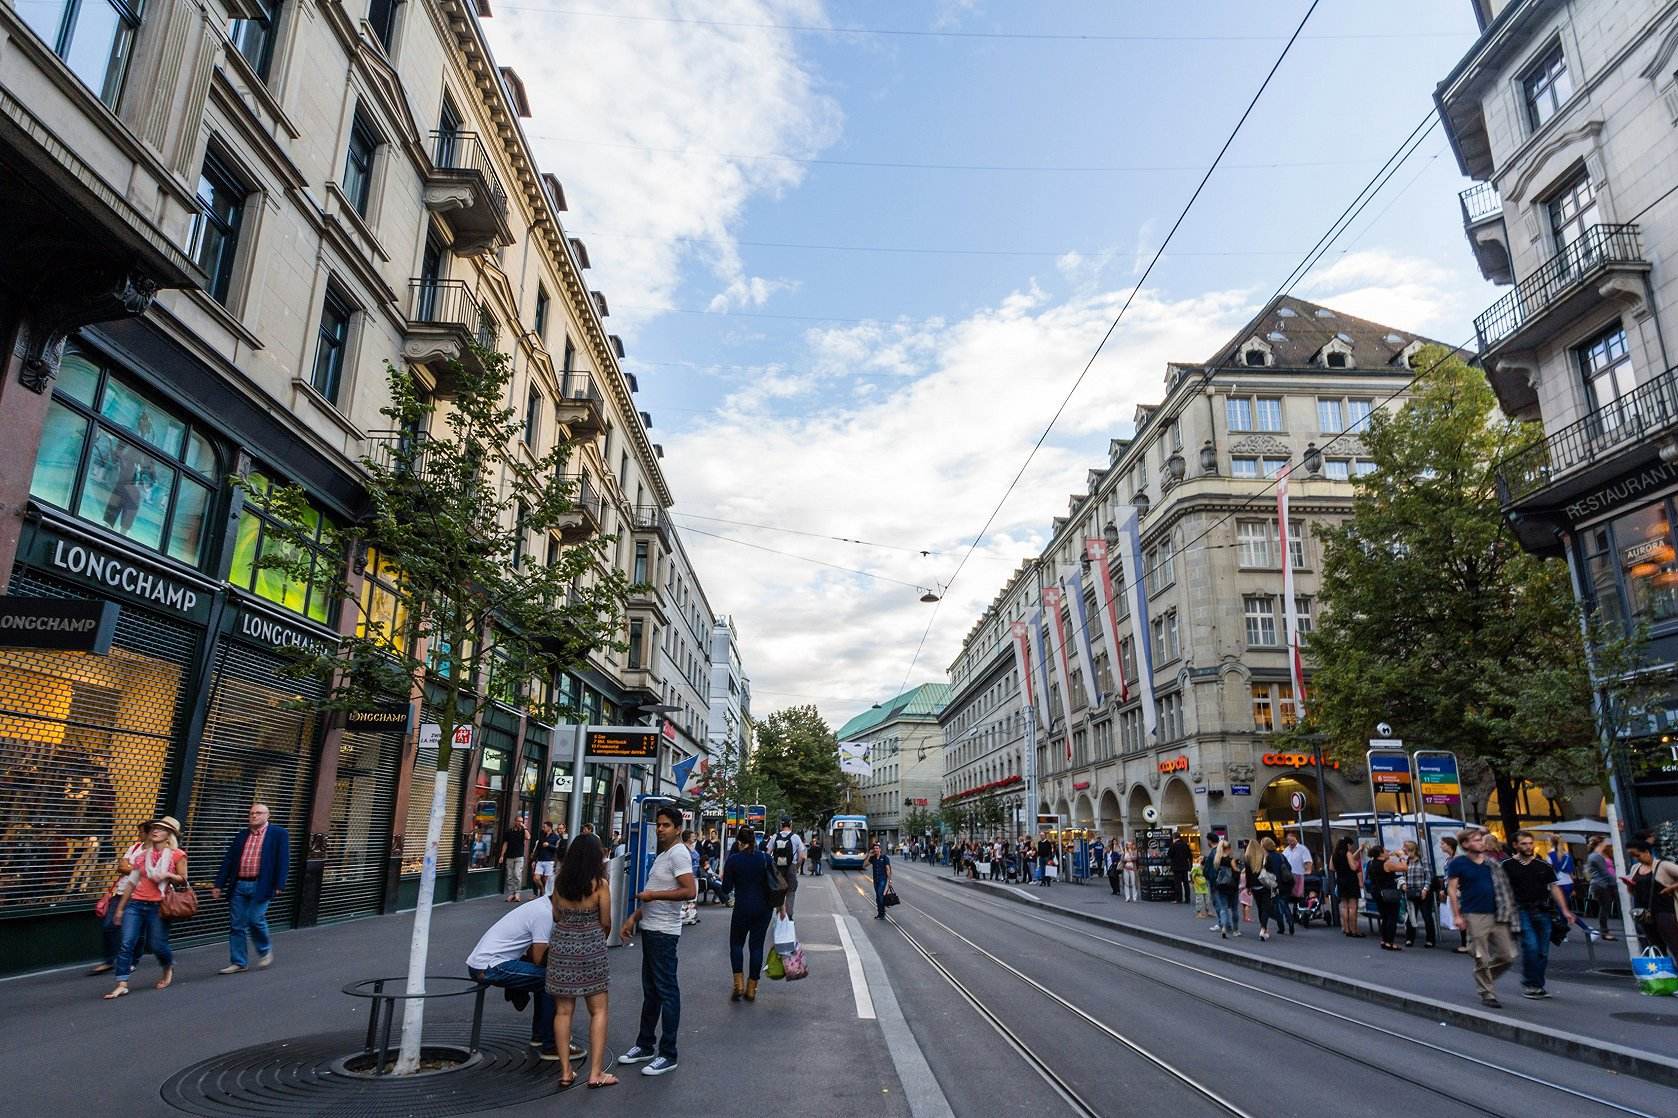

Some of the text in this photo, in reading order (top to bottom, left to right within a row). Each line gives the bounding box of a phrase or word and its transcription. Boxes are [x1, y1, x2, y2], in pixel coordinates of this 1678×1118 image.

[1566, 462, 1678, 520] RESTAURANT
[1626, 539, 1665, 559] AURORA
[53, 539, 197, 613] LONGCHAMP
[0, 615, 96, 633] ONGCHAMP
[348, 712, 407, 723] LONGCHAMP
[1263, 752, 1307, 768] coop
